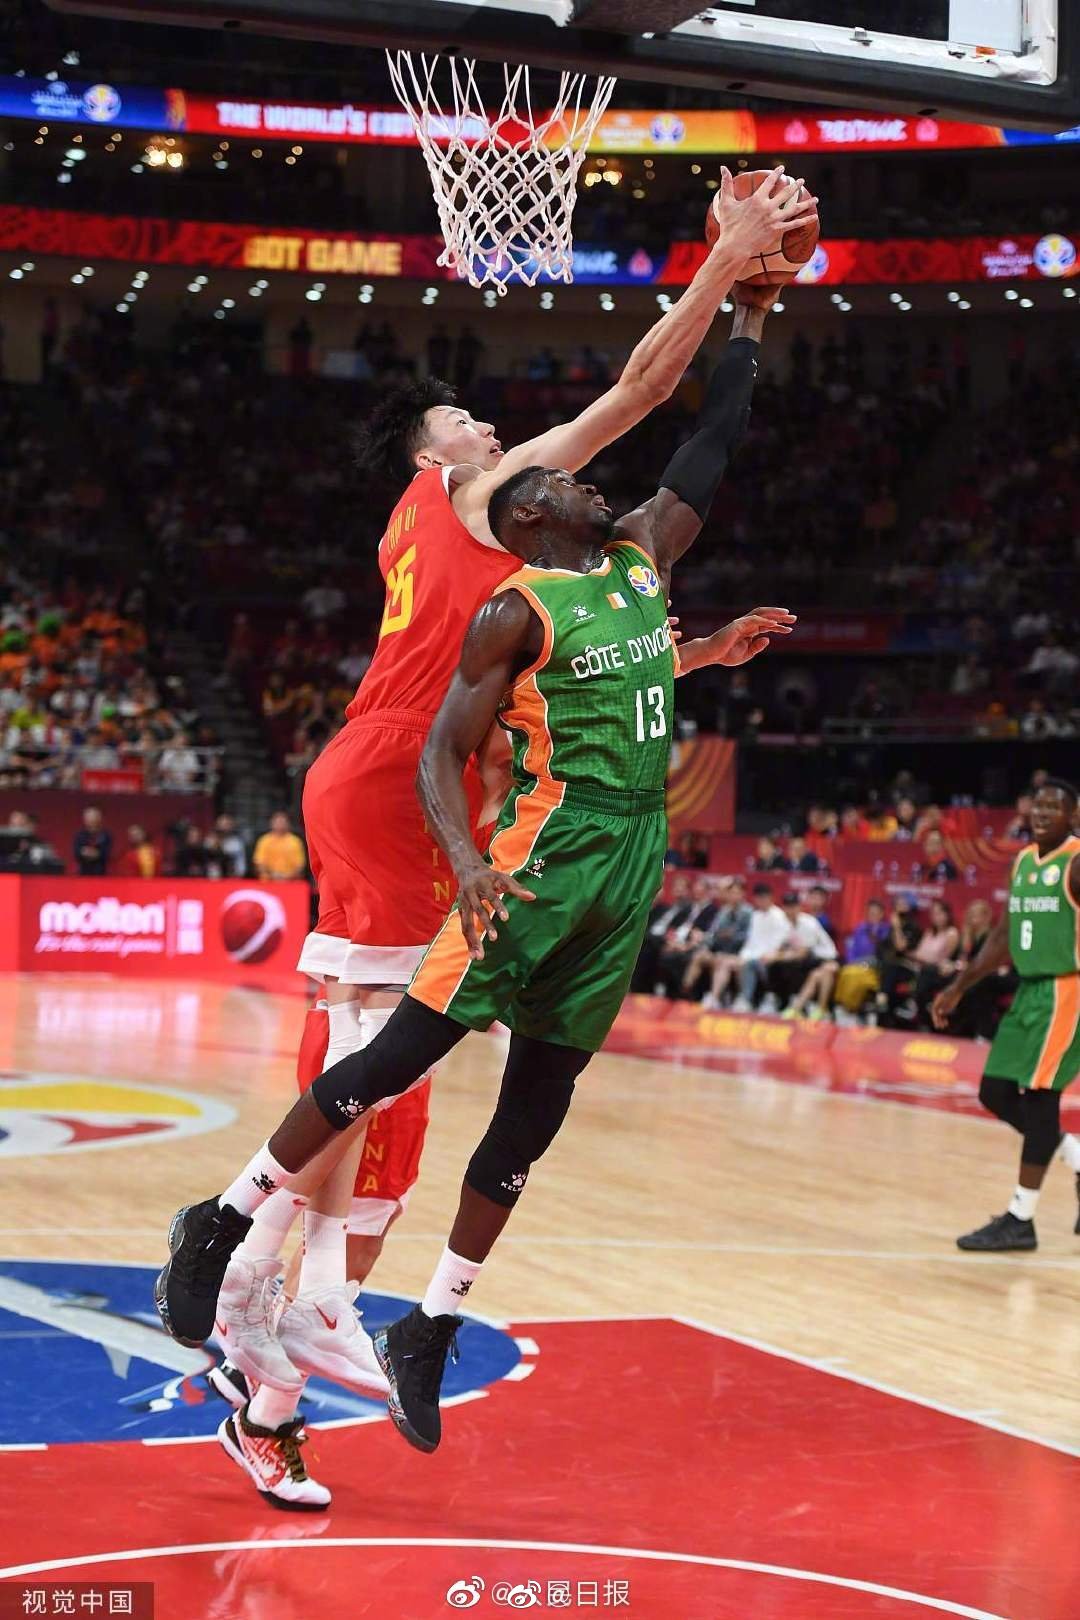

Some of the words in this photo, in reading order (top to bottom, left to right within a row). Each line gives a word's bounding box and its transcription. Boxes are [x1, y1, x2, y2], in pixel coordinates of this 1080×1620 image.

[306, 238, 403, 276] GAME
[570, 644, 625, 679] CÔTE
[635, 685, 667, 743] 13
[40, 897, 165, 934] molten
[1020, 919, 1033, 951] 6
